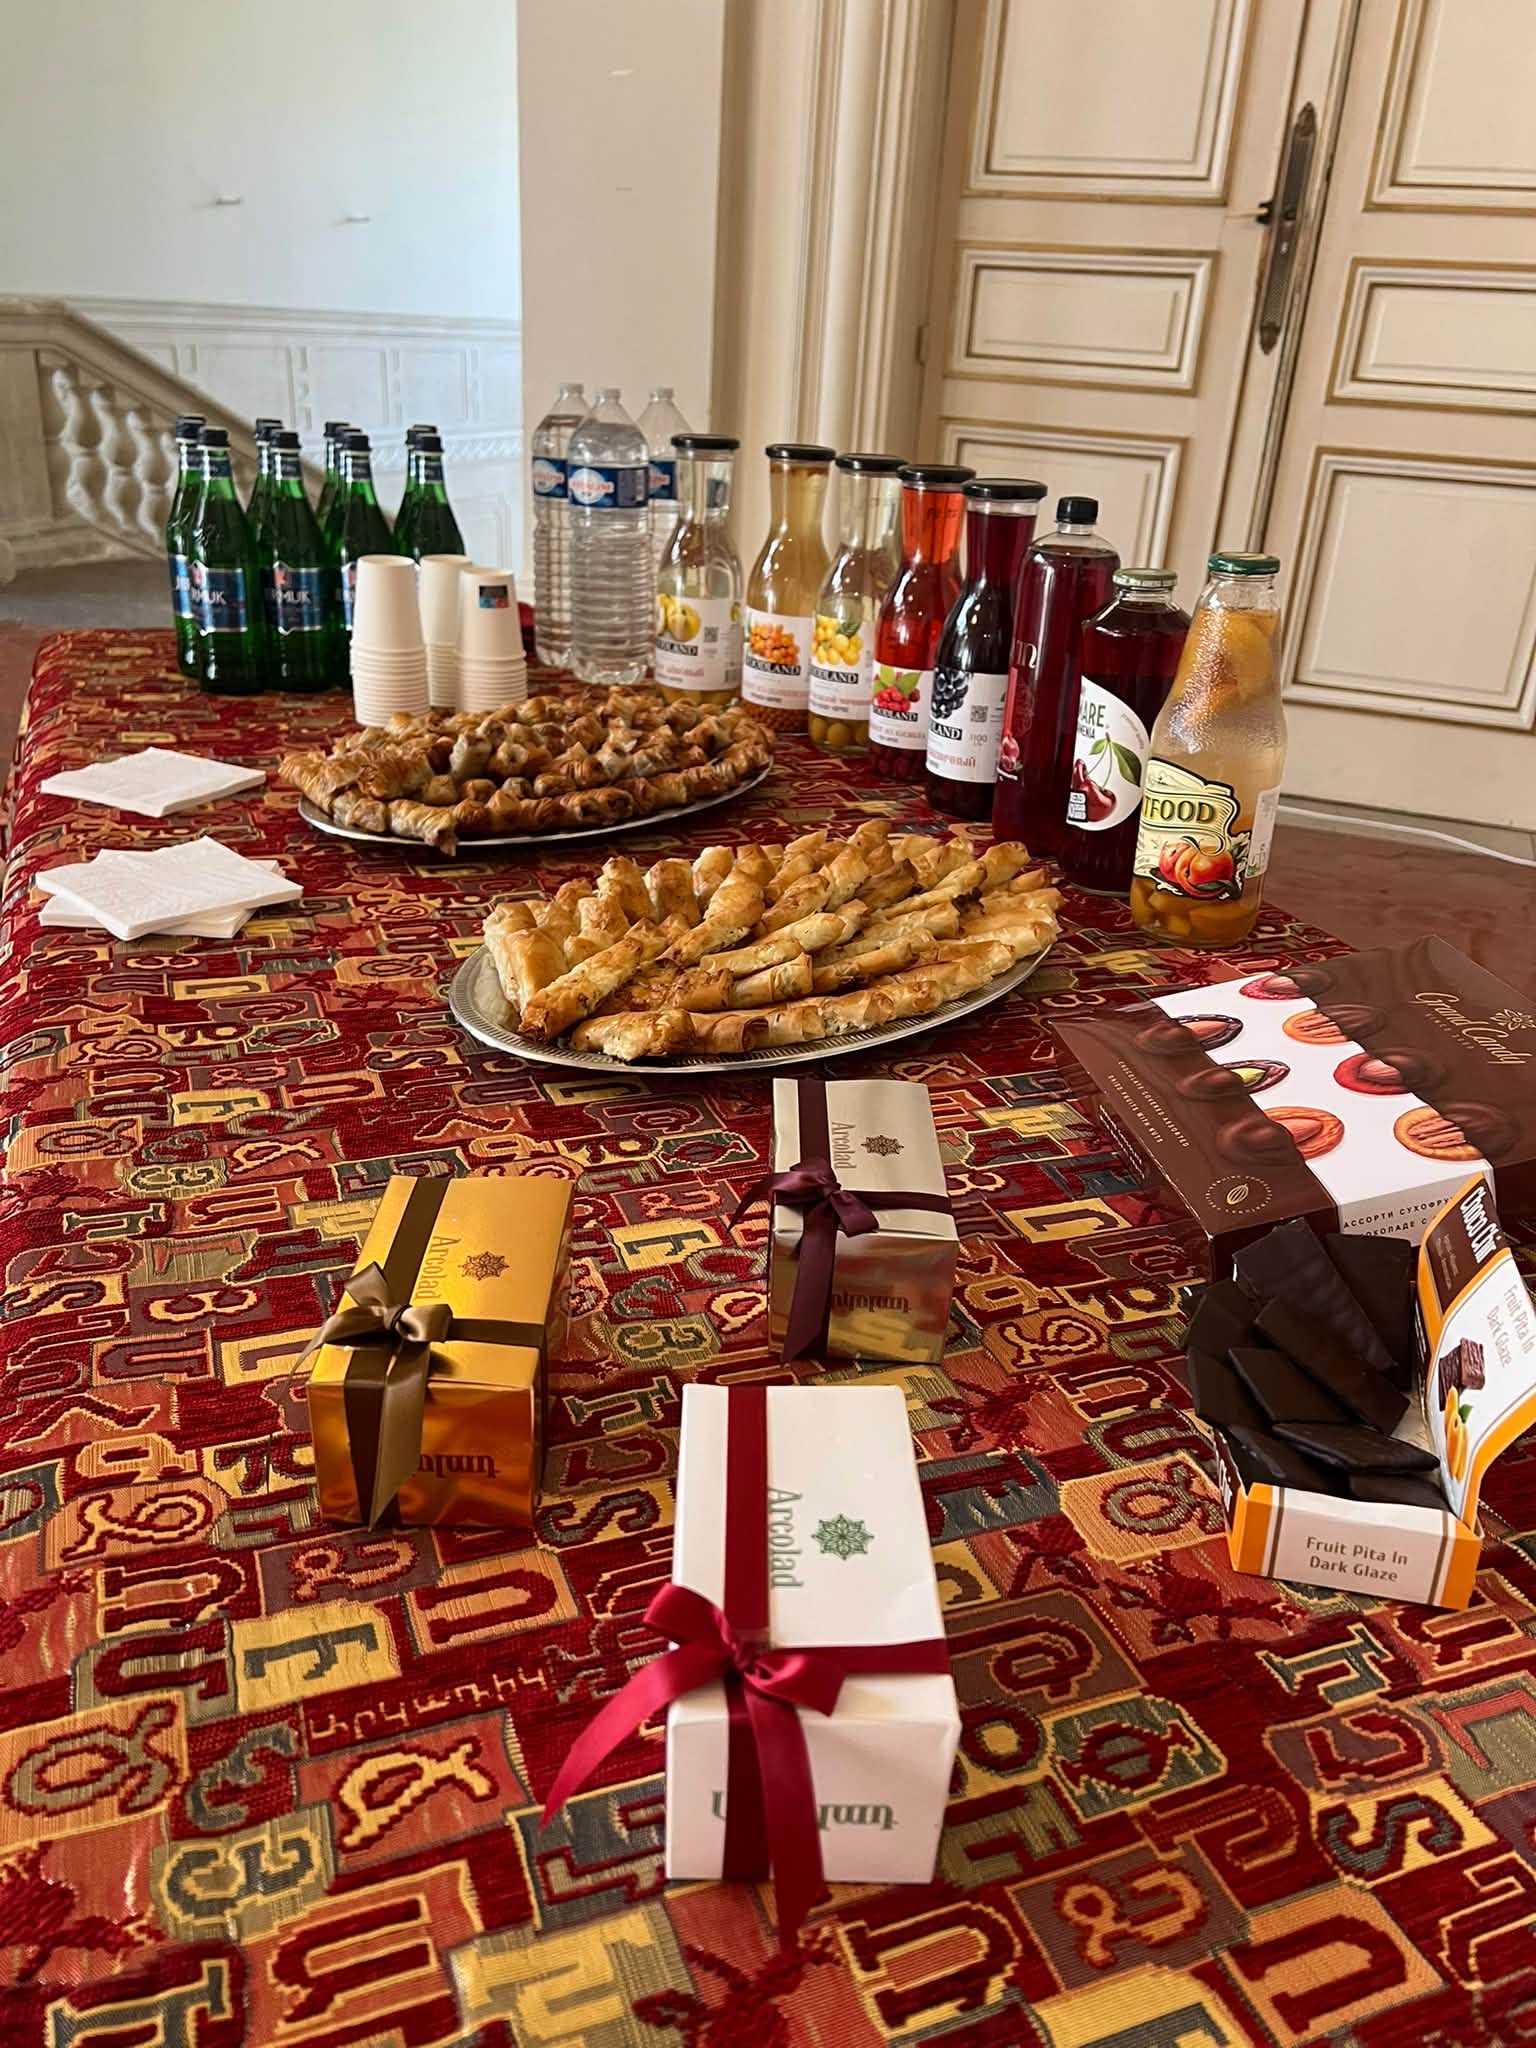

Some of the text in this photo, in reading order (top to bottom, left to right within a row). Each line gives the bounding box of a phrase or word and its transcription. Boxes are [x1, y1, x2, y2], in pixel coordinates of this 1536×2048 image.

[1408, 992, 1533, 1064] Grand Candy
[831, 1121, 856, 1169] Arcolad
[1343, 1196, 1454, 1229] АССОРТИ СУХОФРУ
[1363, 1220, 1417, 1237] ОКОЛАДЕ
[1460, 1186, 1488, 1238] Choco
[415, 1235, 462, 1300] Arcolad
[1487, 1305, 1504, 1337] Dark
[1503, 1284, 1521, 1318] Fruit
[1513, 1310, 1530, 1340] Pita
[768, 1487, 804, 1589] Arcolad
[1306, 1536, 1408, 1566] Fruit Pita In
[1310, 1555, 1398, 1582] Dark Glaze
